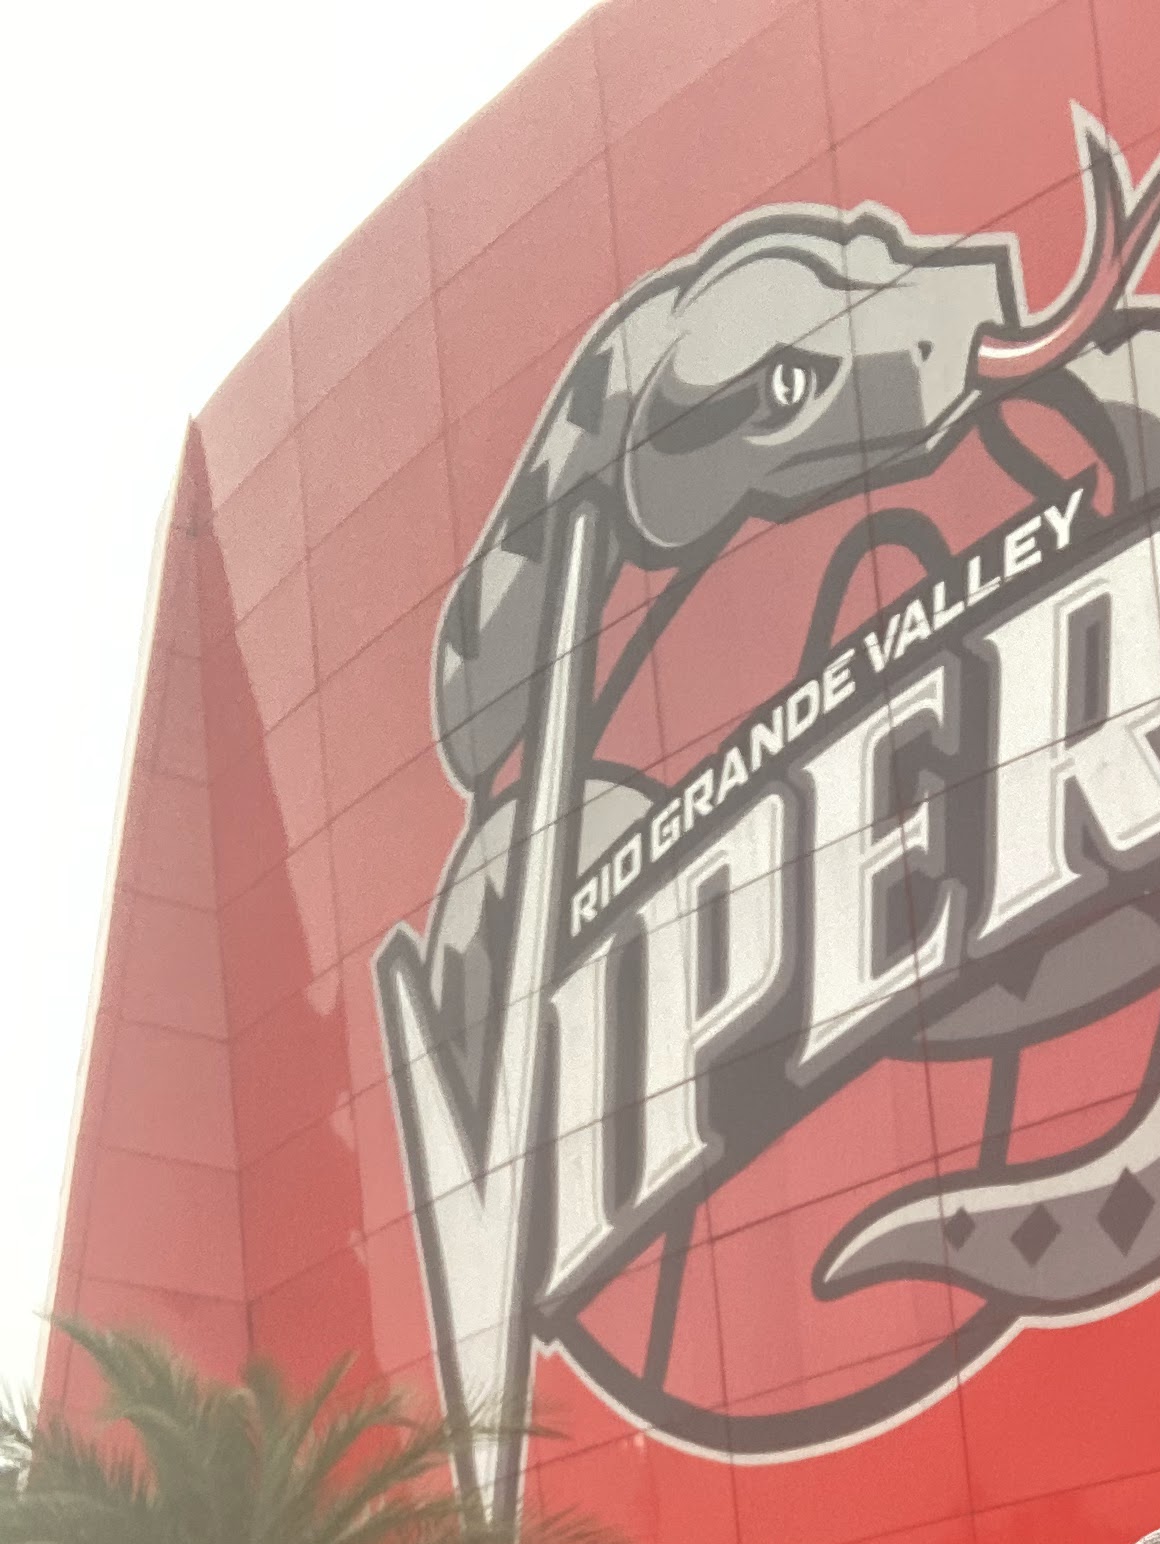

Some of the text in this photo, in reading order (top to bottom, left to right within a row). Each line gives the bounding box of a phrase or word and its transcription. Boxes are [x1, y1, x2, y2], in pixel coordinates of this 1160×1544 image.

[569, 487, 1084, 937] RIO GRANDE VALLEY
